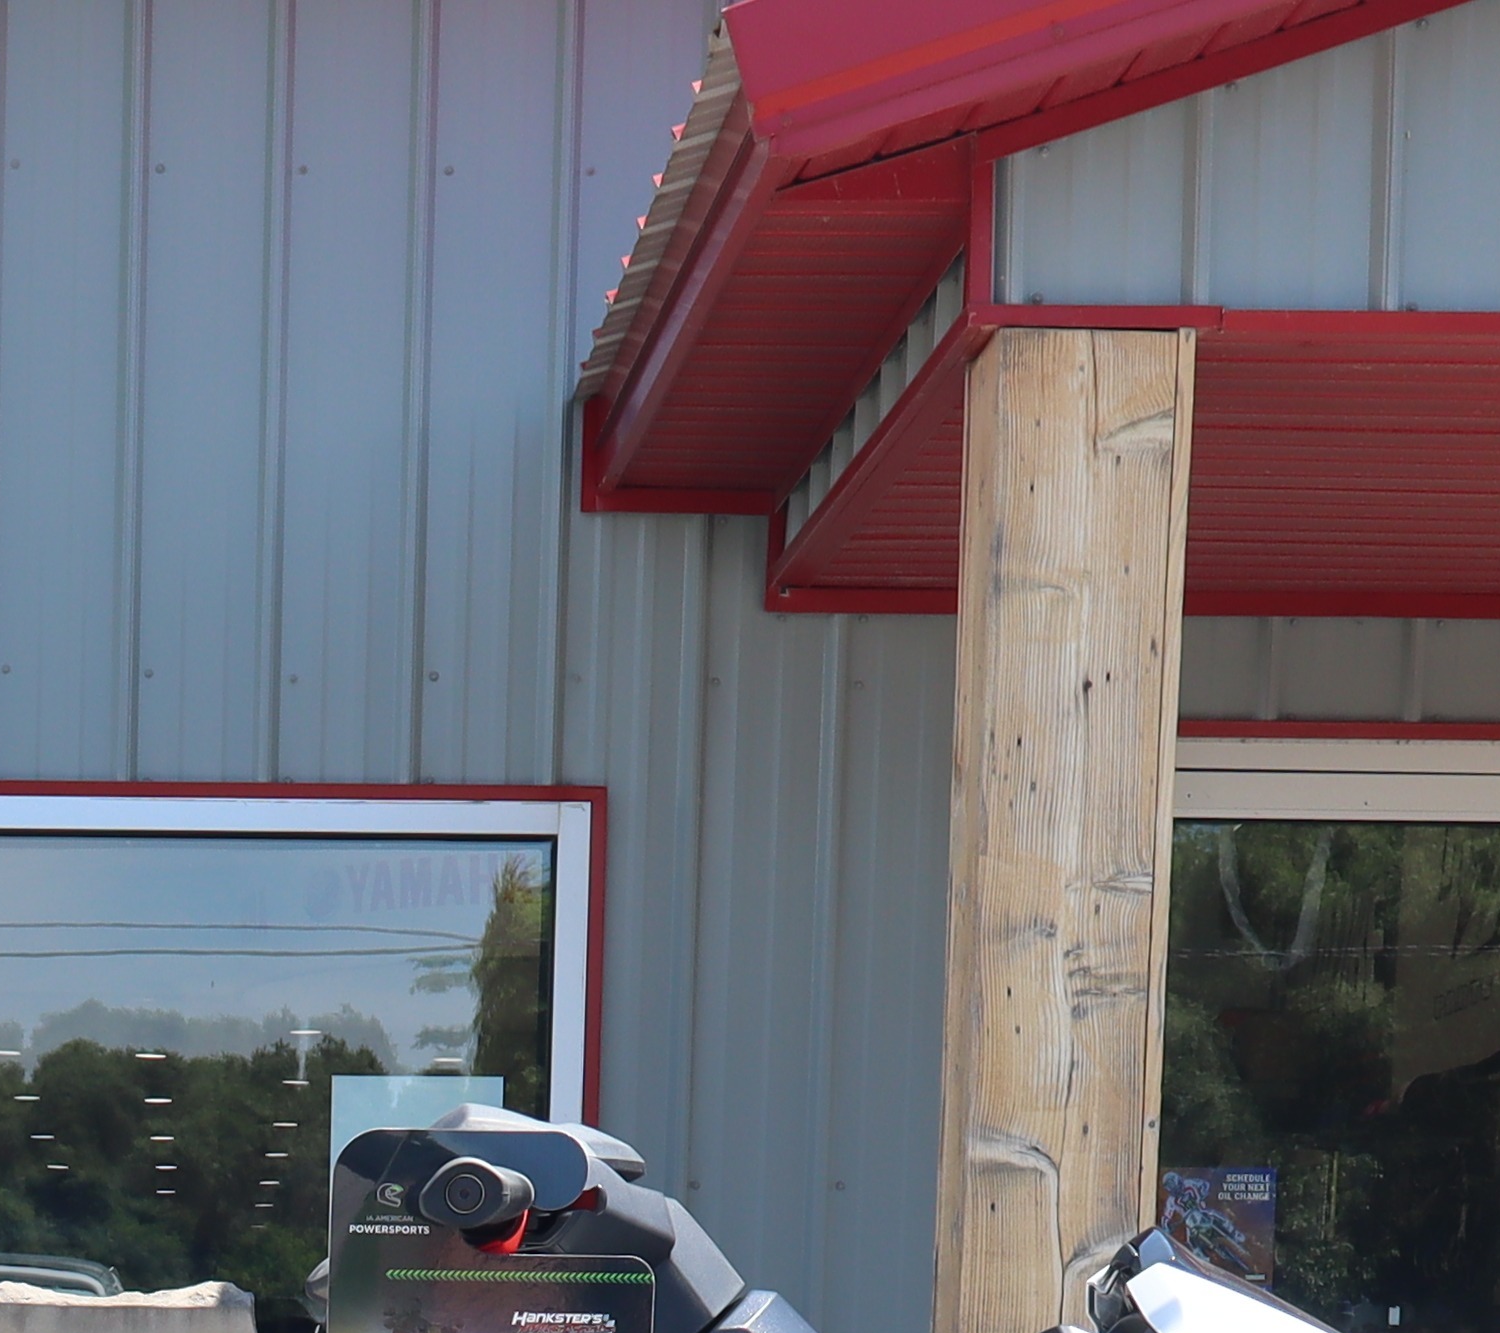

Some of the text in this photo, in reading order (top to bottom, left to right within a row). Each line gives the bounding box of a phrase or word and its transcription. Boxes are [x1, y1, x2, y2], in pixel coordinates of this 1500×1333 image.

[345, 852, 510, 912] YAMAH
[1226, 1173, 1270, 1182] SCHEDULE
[1222, 1183, 1270, 1191] YOUR NEXT
[1218, 1192, 1270, 1200] OIL CHANGE
[349, 1224, 430, 1235] POWERSPORTS
